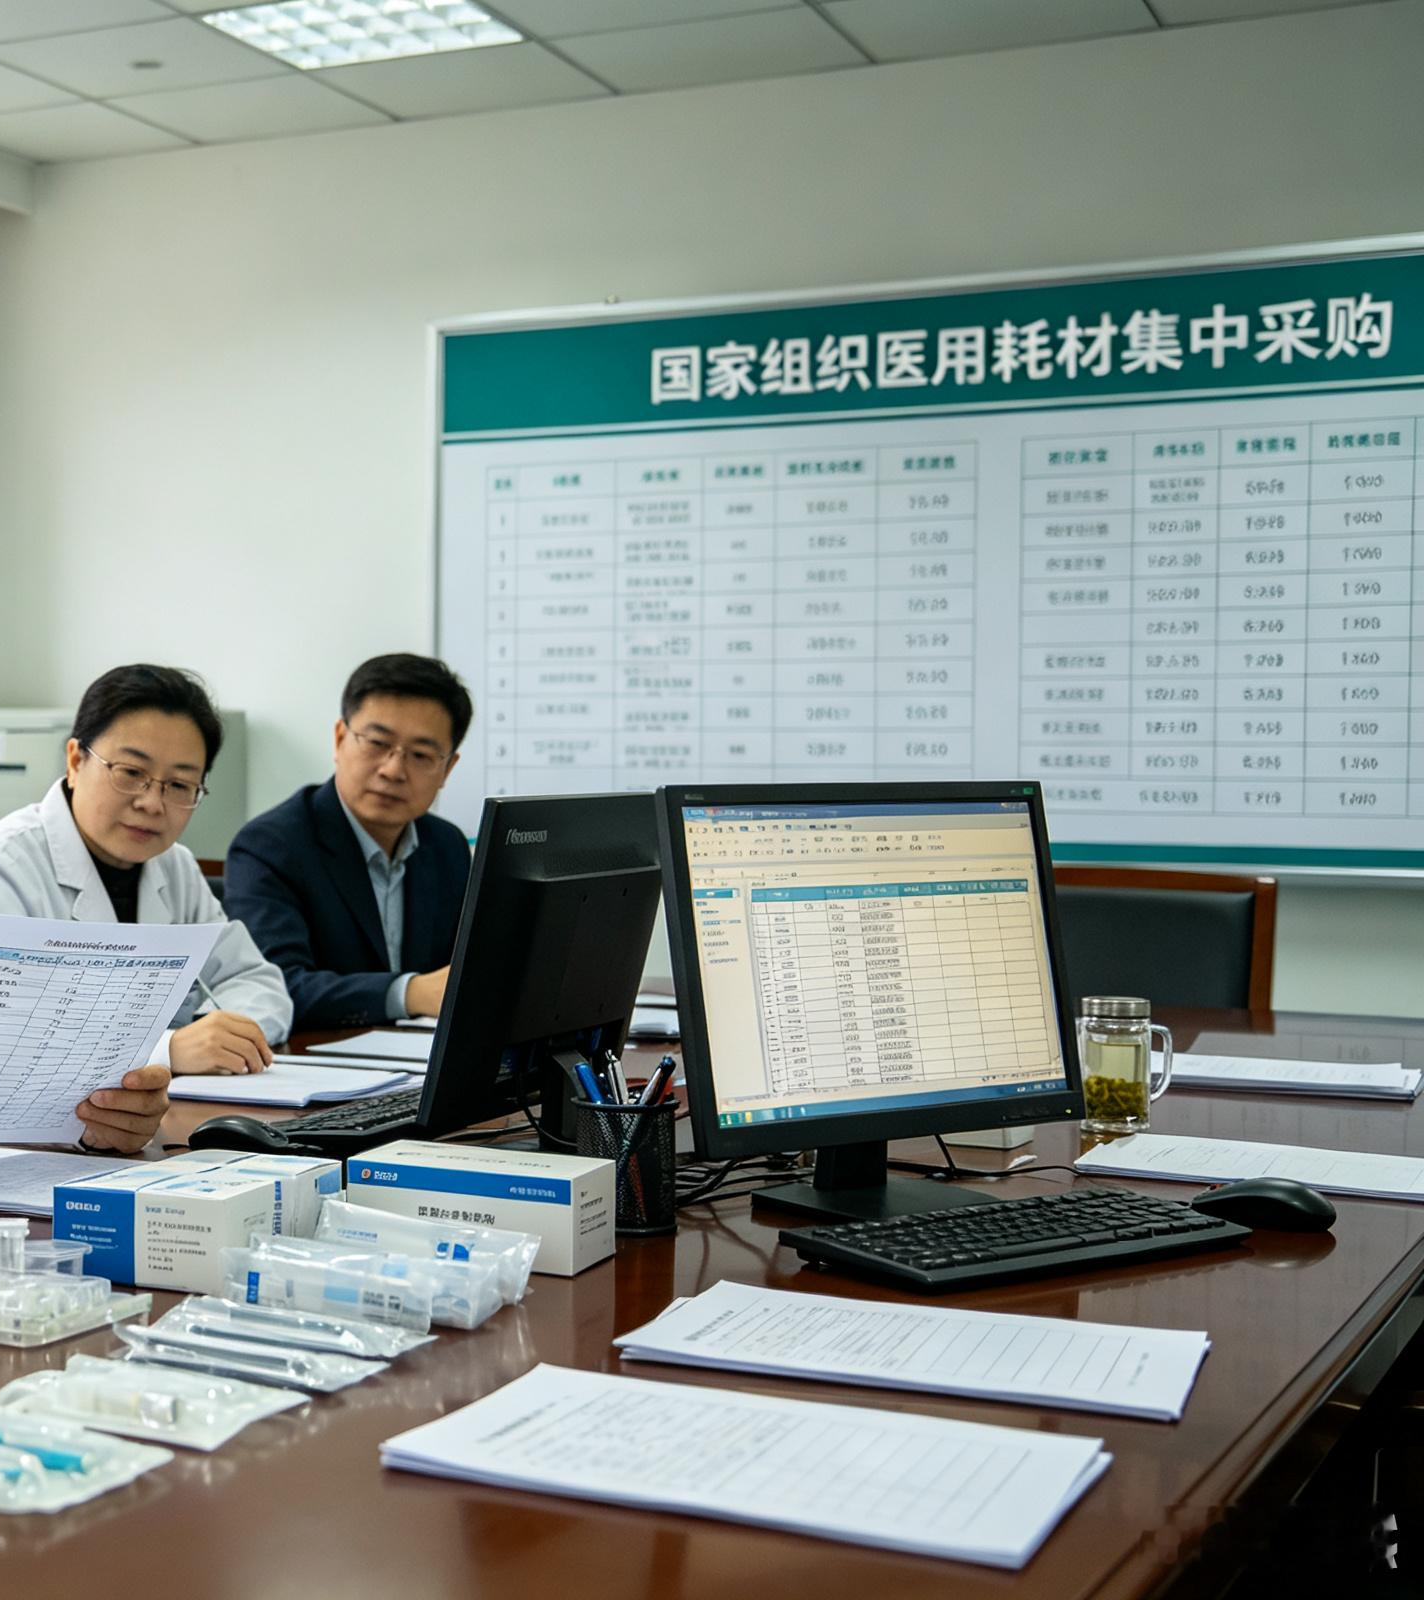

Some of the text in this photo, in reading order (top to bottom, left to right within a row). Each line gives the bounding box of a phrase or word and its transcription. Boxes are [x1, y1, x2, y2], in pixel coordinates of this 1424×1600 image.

[651, 293, 1392, 404] 国家组织医用耗材集中采购
